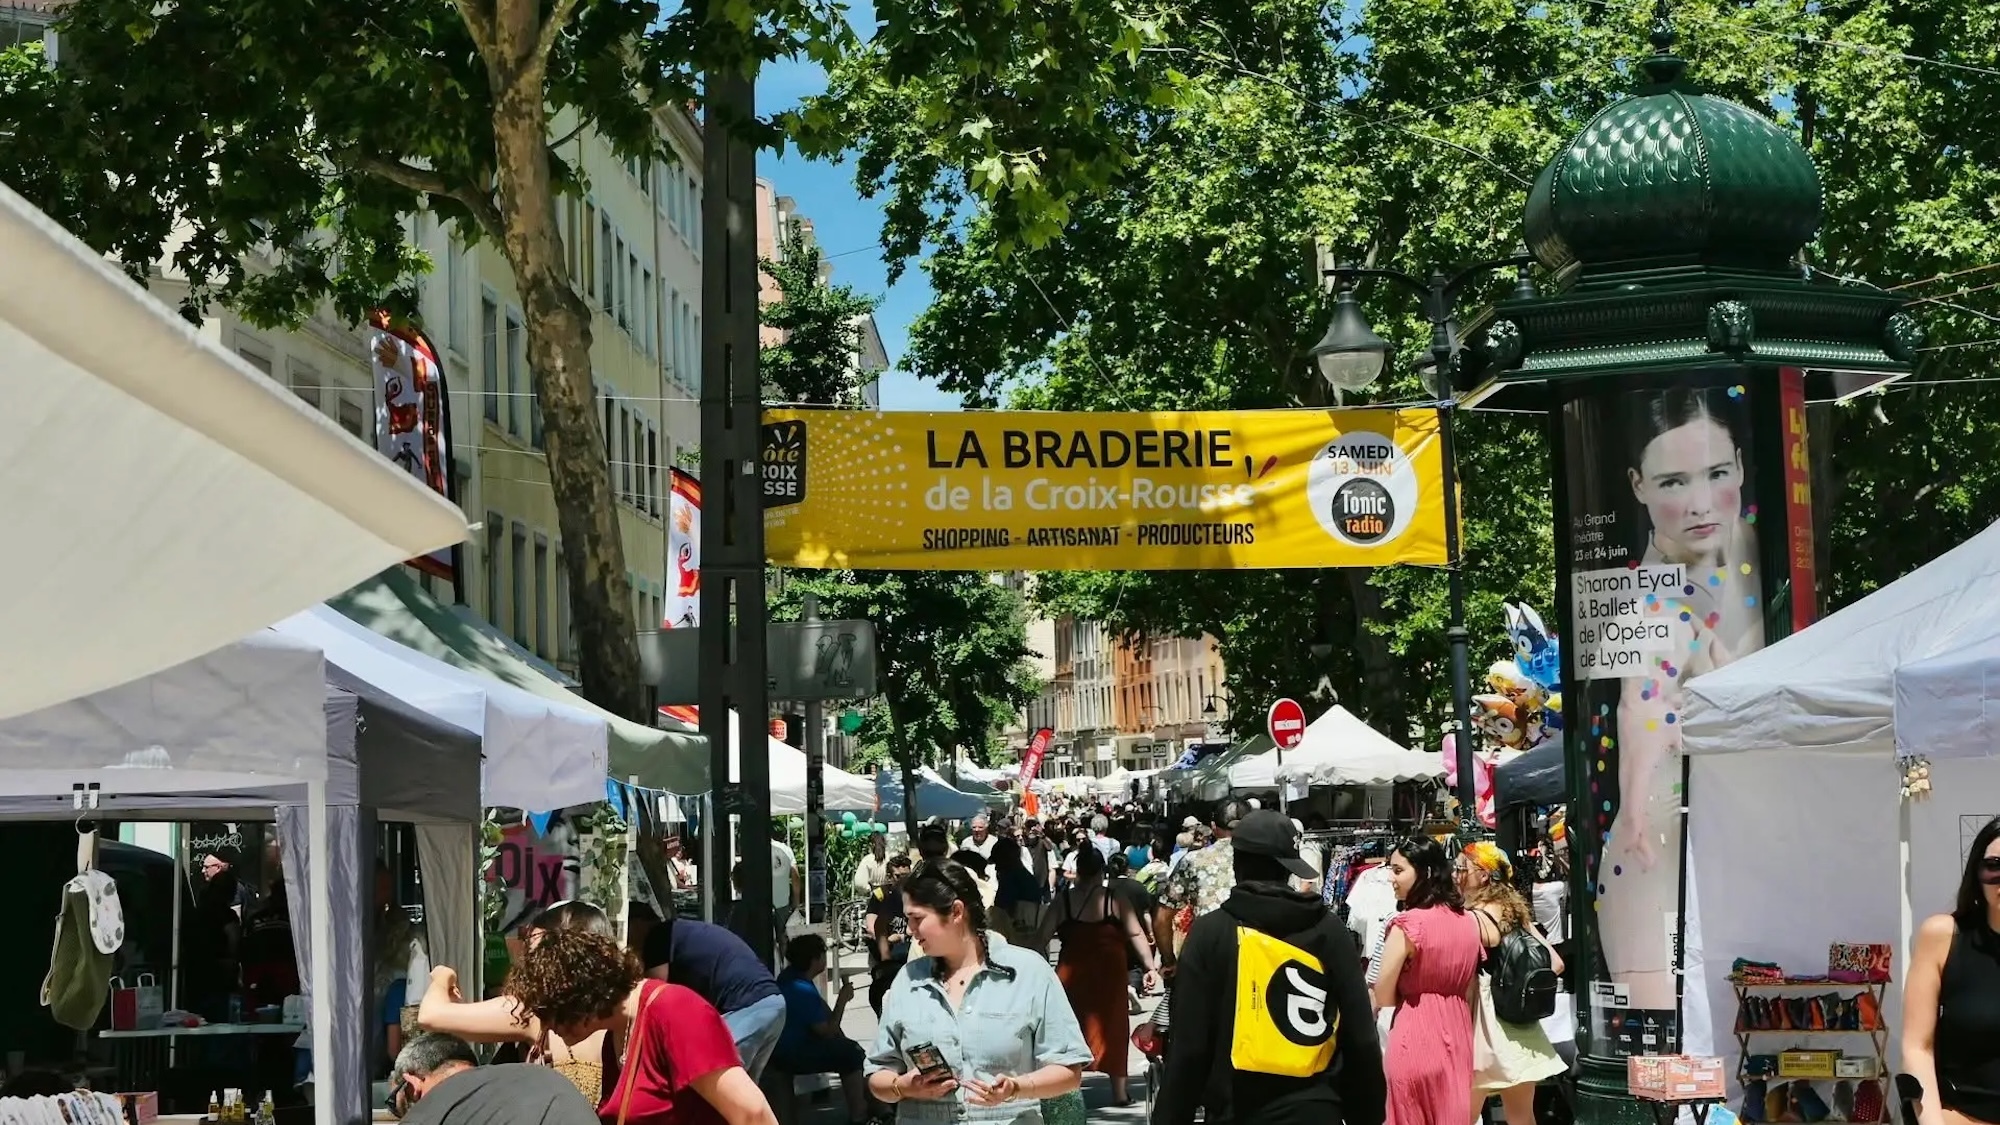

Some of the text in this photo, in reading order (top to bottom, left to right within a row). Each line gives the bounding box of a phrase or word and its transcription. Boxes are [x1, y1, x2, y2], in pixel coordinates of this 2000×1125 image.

[927, 430, 1233, 469] LA BRADERIE
[1328, 445, 1394, 459] SAMEDI
[762, 465, 797, 480] ROIX
[1332, 461, 1393, 475] 13 JUIN
[764, 481, 797, 496] SSE
[925, 475, 1255, 512] de la Croix-Rousse
[1341, 490, 1387, 515] Tonic
[1346, 516, 1383, 534] radio
[1584, 511, 1616, 526] Grand
[923, 528, 1009, 549] SHOPPING
[1027, 527, 1120, 547] ARTISANAT
[1138, 523, 1254, 545] PRODUCTEURS
[1575, 544, 1628, 562] 23 et 24 juin
[1577, 567, 1681, 594] Sharon Eyal
[1578, 597, 1638, 619] & Ballet
[1580, 621, 1669, 644] de l'Opéra
[1581, 647, 1641, 669] de Lyon
